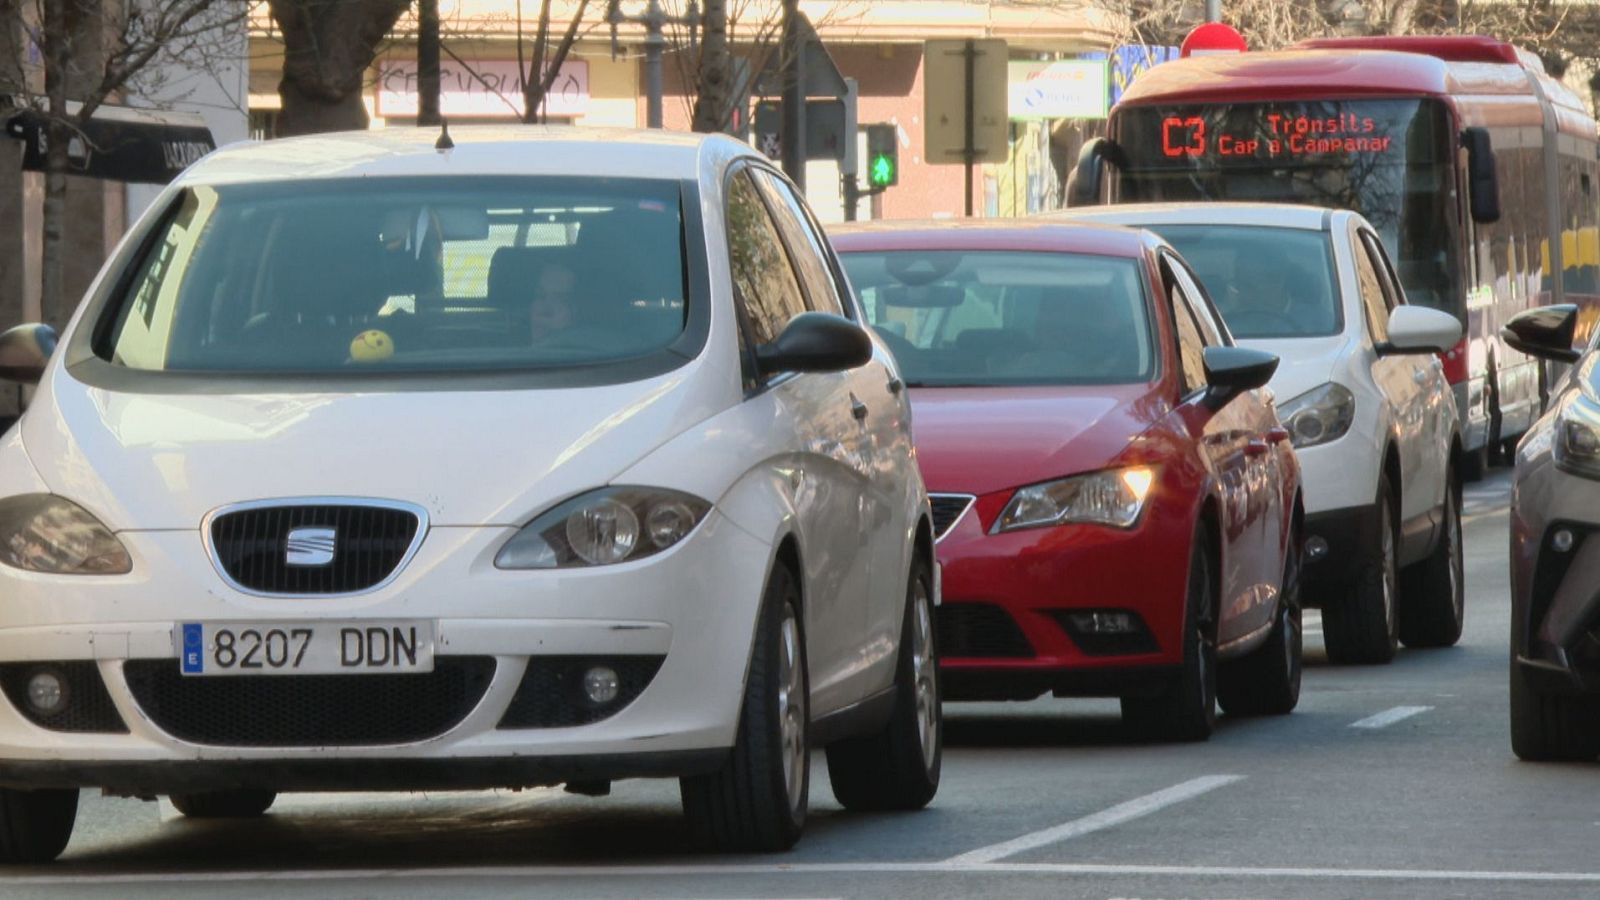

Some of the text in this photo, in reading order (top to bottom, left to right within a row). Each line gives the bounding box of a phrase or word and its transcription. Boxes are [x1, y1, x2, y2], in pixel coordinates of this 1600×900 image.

[1162, 116, 1205, 157] C3
[1218, 135, 1391, 155] Cap a Campanar
[188, 627, 417, 669] E 8207 DDN
